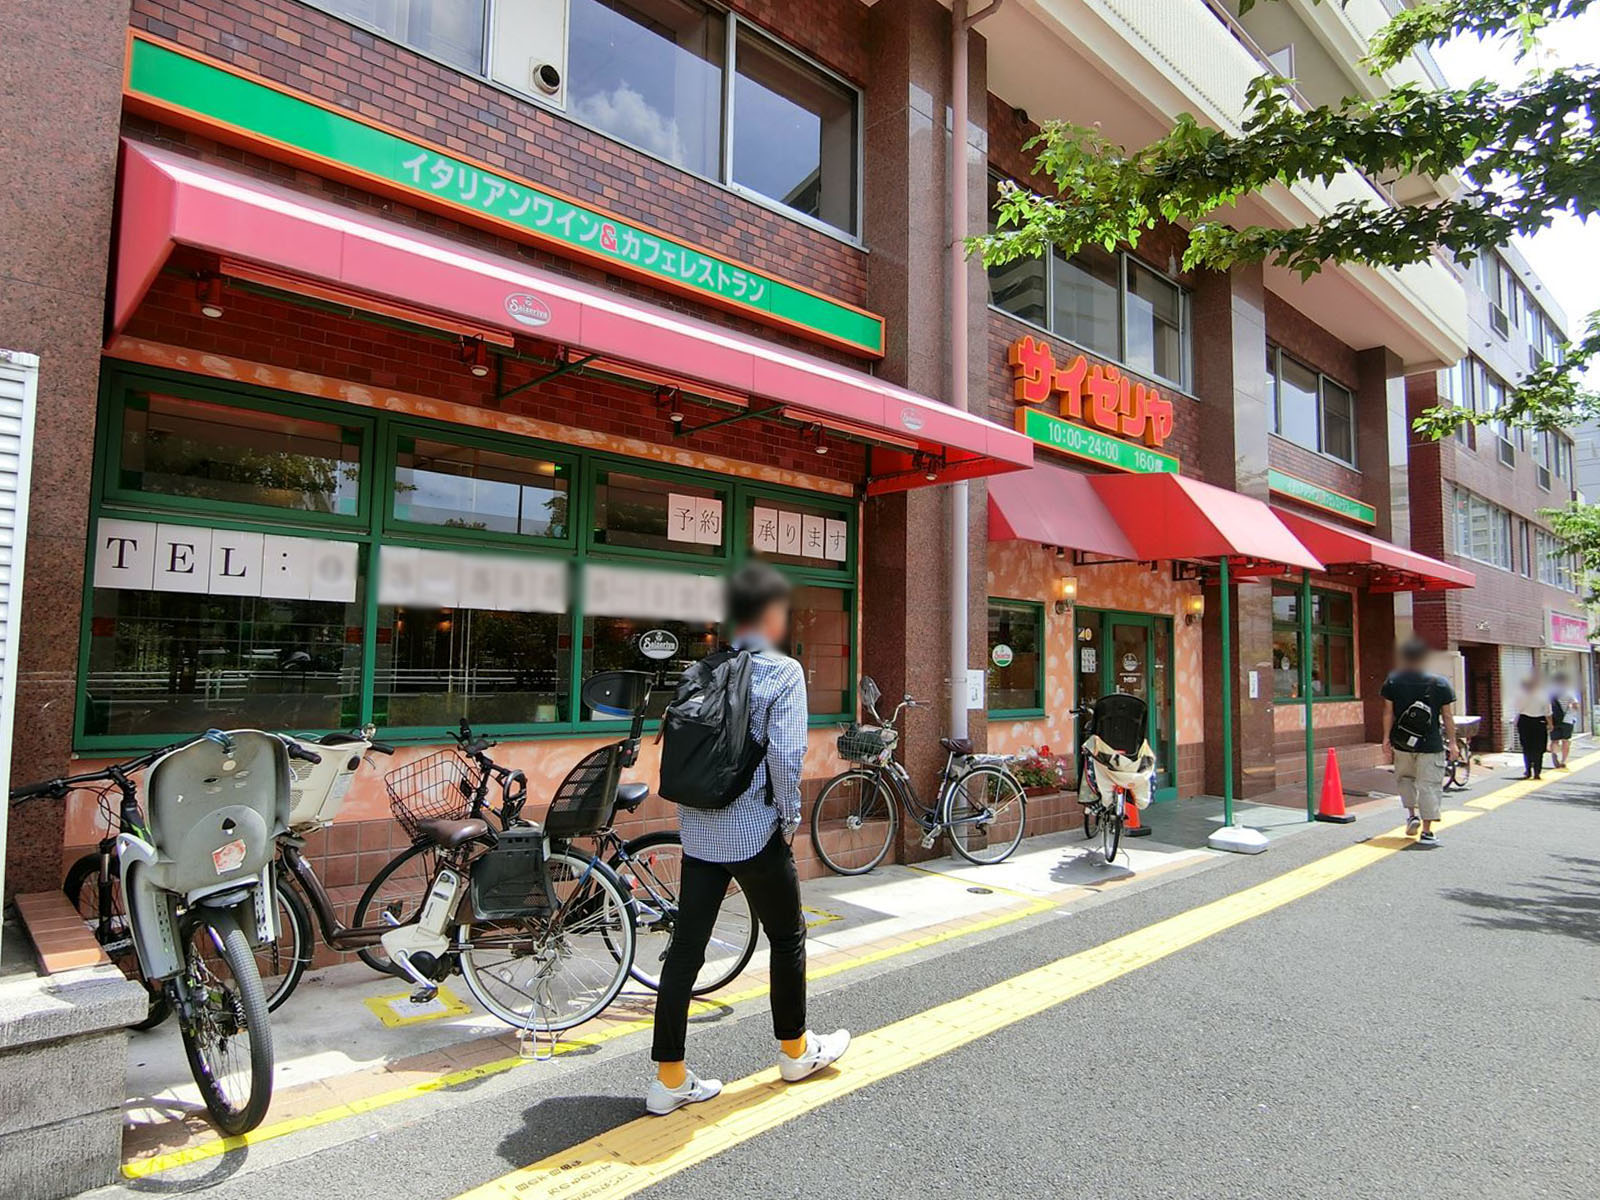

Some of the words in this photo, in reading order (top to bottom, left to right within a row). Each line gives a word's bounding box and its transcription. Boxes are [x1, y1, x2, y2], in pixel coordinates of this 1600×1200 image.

[1010, 335, 1173, 447] サイゼリヤ
[674, 507, 720, 535] 予約
[757, 519, 846, 551] 承ります
